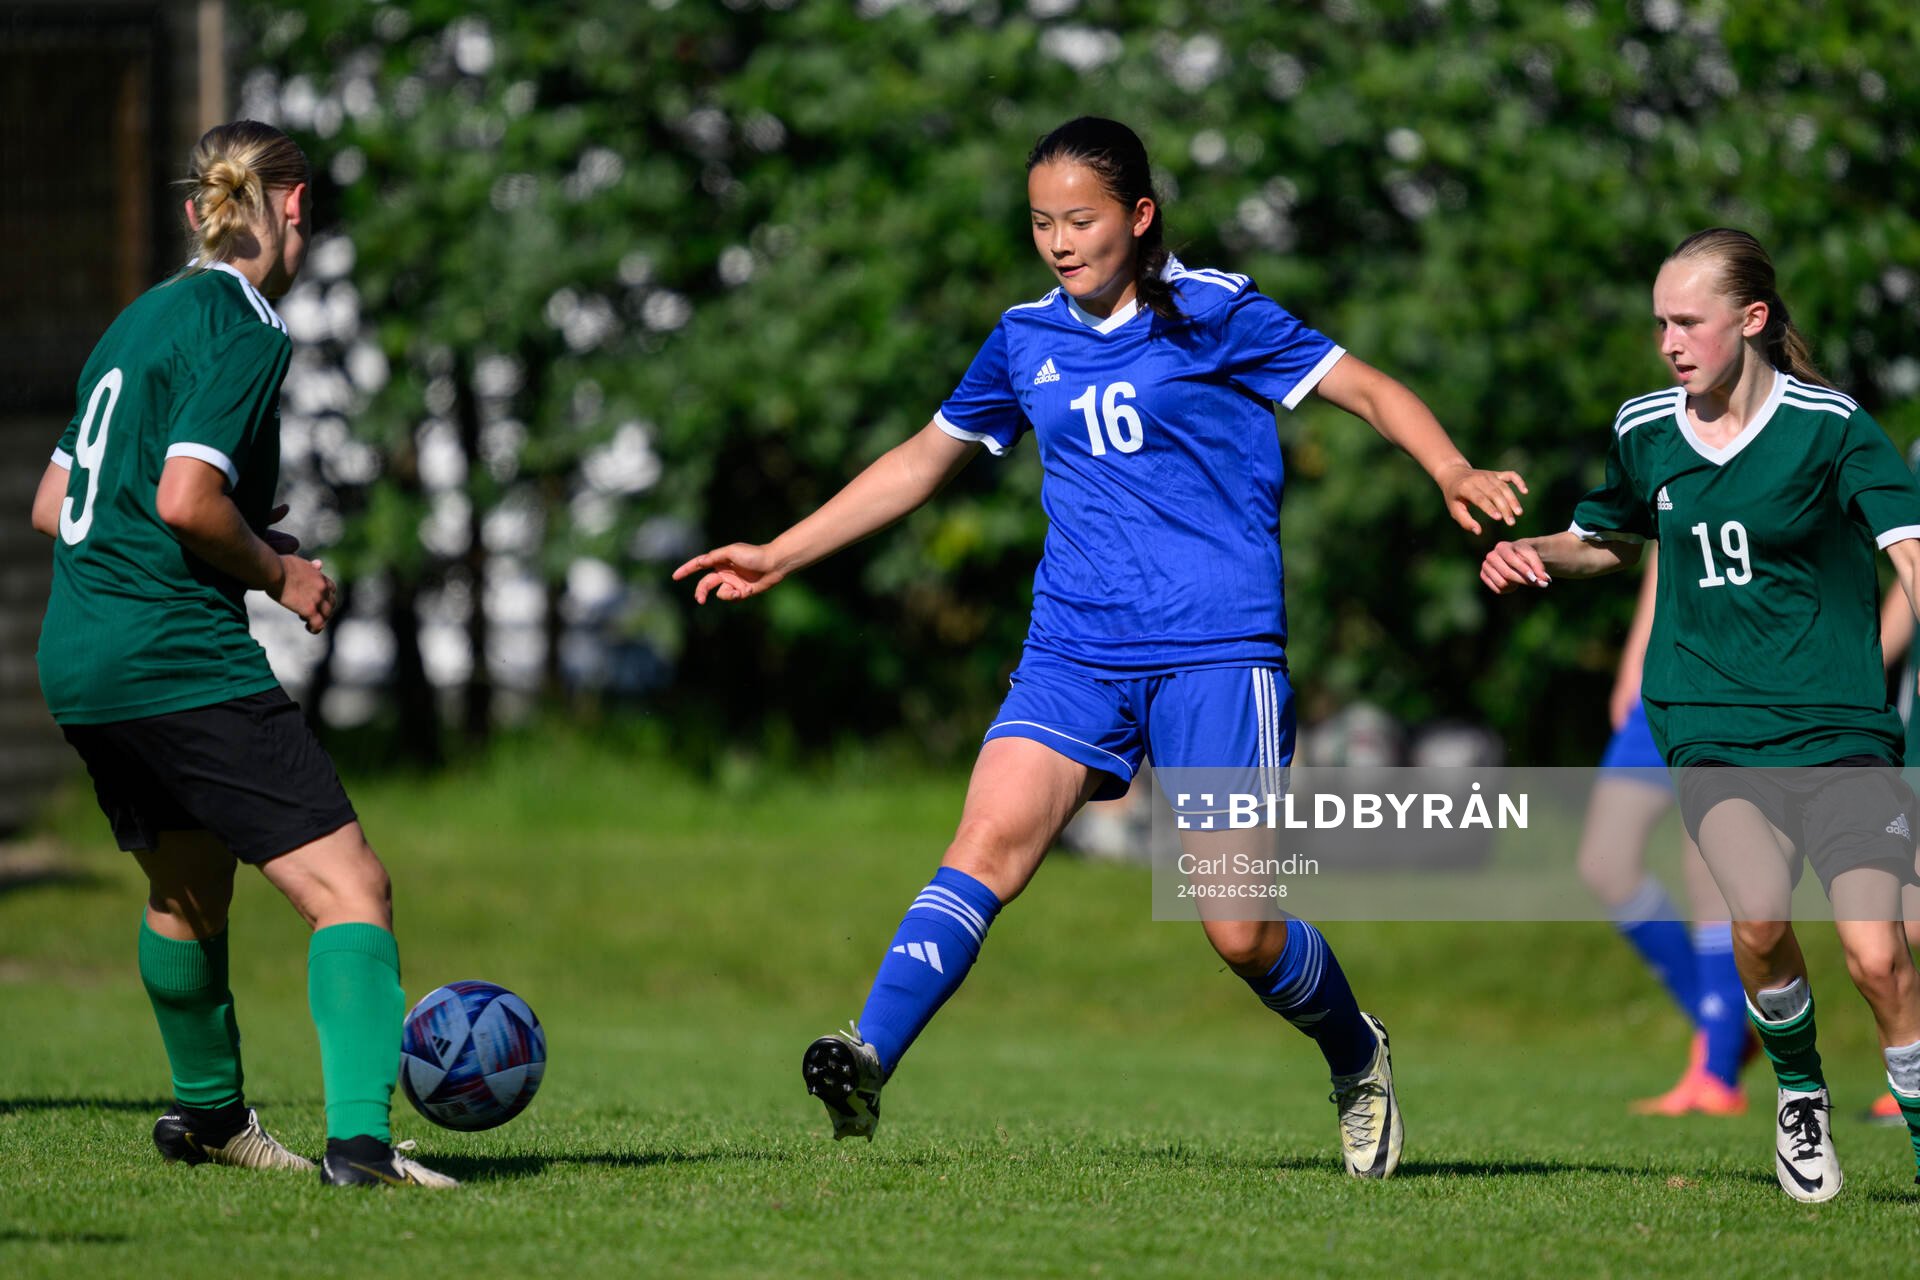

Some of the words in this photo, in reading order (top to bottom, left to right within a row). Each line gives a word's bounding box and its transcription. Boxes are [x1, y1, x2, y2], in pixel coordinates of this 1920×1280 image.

[1034, 373, 1060, 385] adidas
[1070, 381, 1143, 456] 16
[59, 367, 123, 546] 9
[1691, 520, 1753, 588] 19
